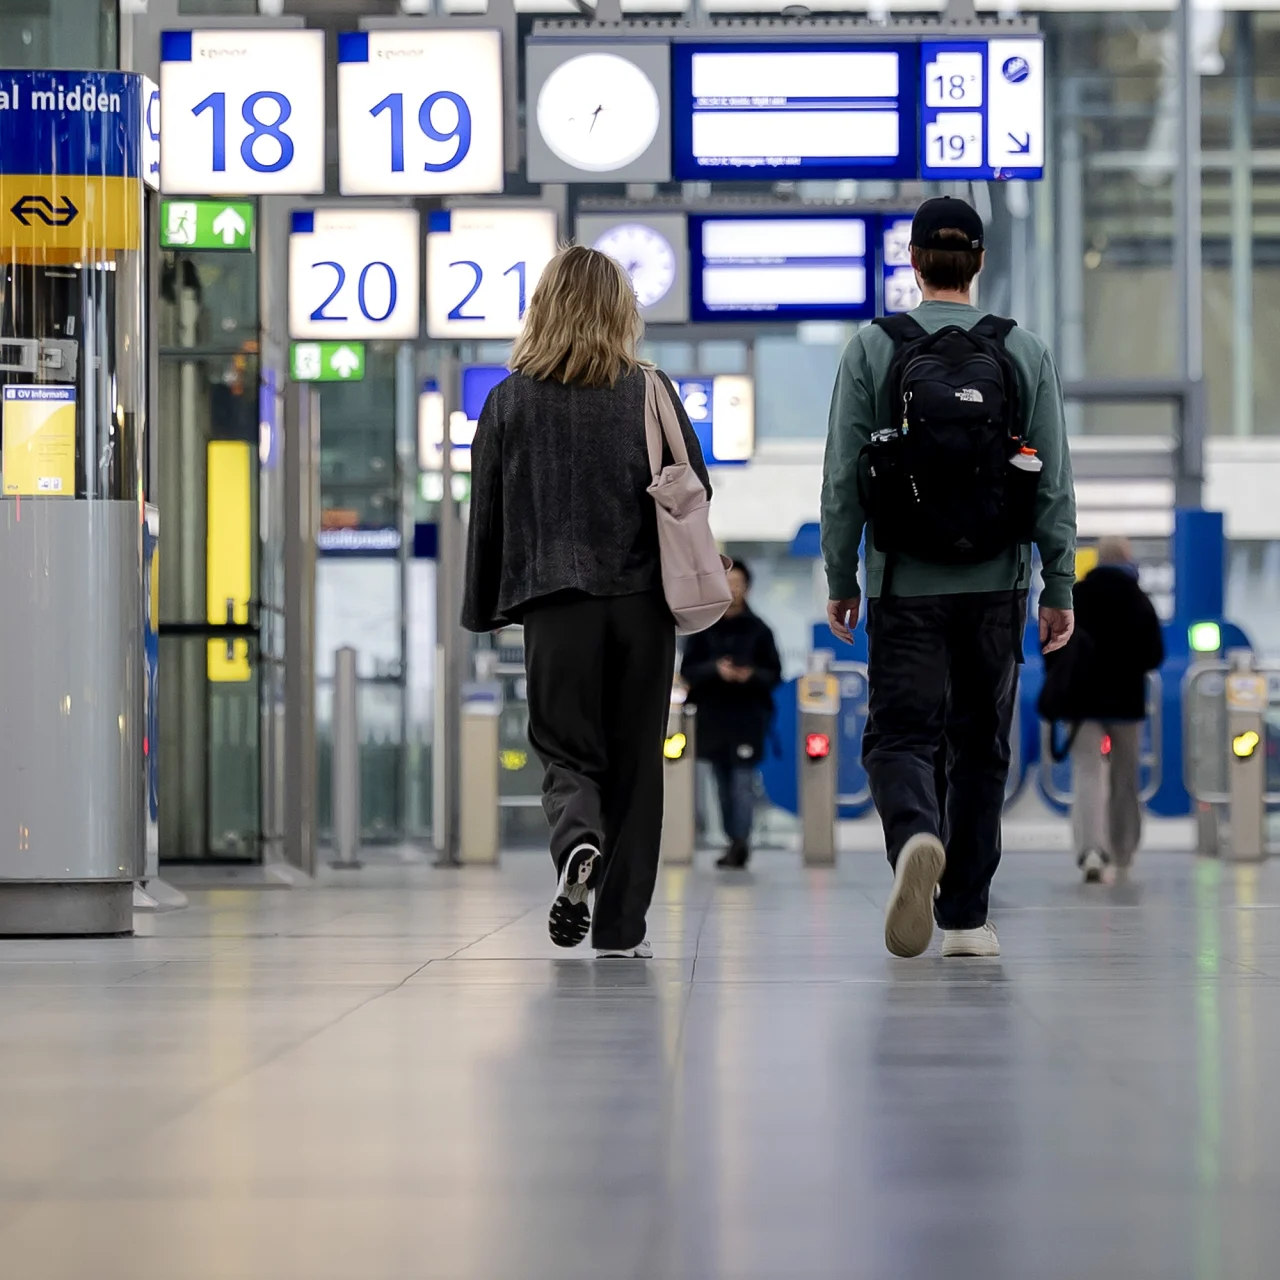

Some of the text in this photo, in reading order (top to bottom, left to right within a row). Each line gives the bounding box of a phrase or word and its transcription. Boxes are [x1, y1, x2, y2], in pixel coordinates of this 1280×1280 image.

[31, 84, 121, 113] midden
[191, 90, 295, 173] 18
[369, 90, 472, 173] 19
[309, 260, 398, 322] 20
[447, 260, 527, 321] 21
[32, 389, 70, 399] Informatie
